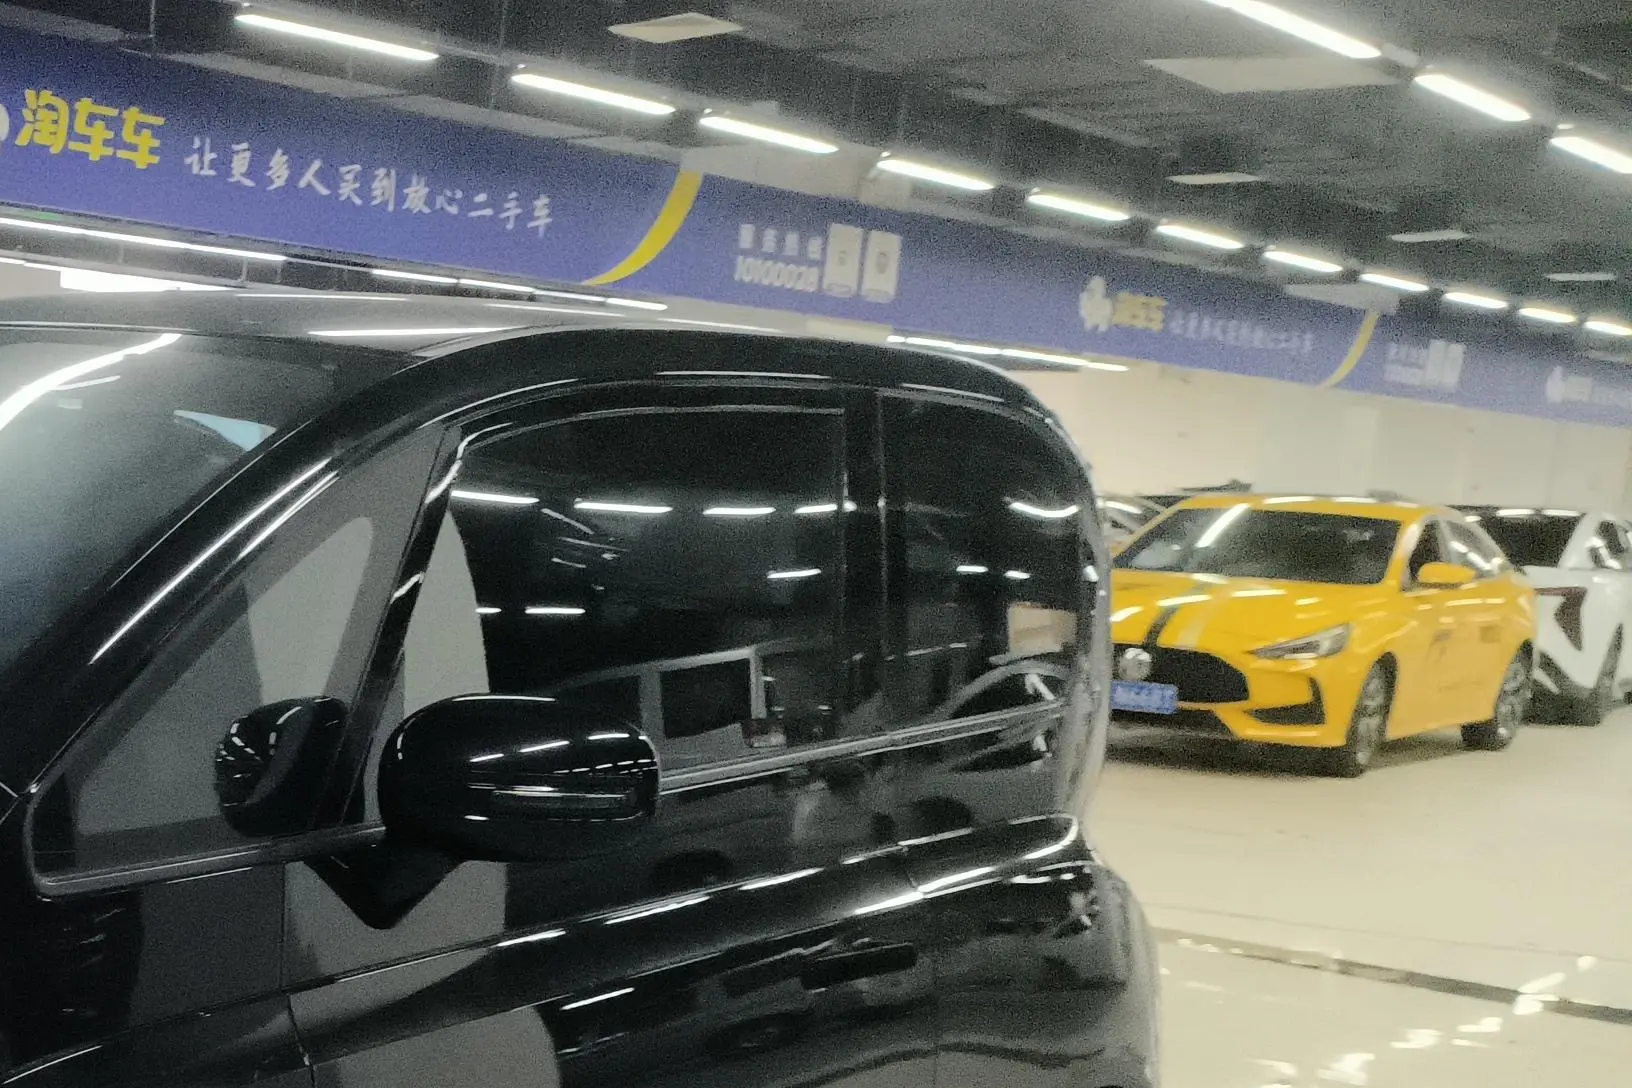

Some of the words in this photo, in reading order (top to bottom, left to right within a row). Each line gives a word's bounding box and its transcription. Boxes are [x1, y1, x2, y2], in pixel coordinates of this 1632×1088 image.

[15, 89, 165, 169] 淘车车
[184, 136, 553, 238] 让更多人买到放心二手车
